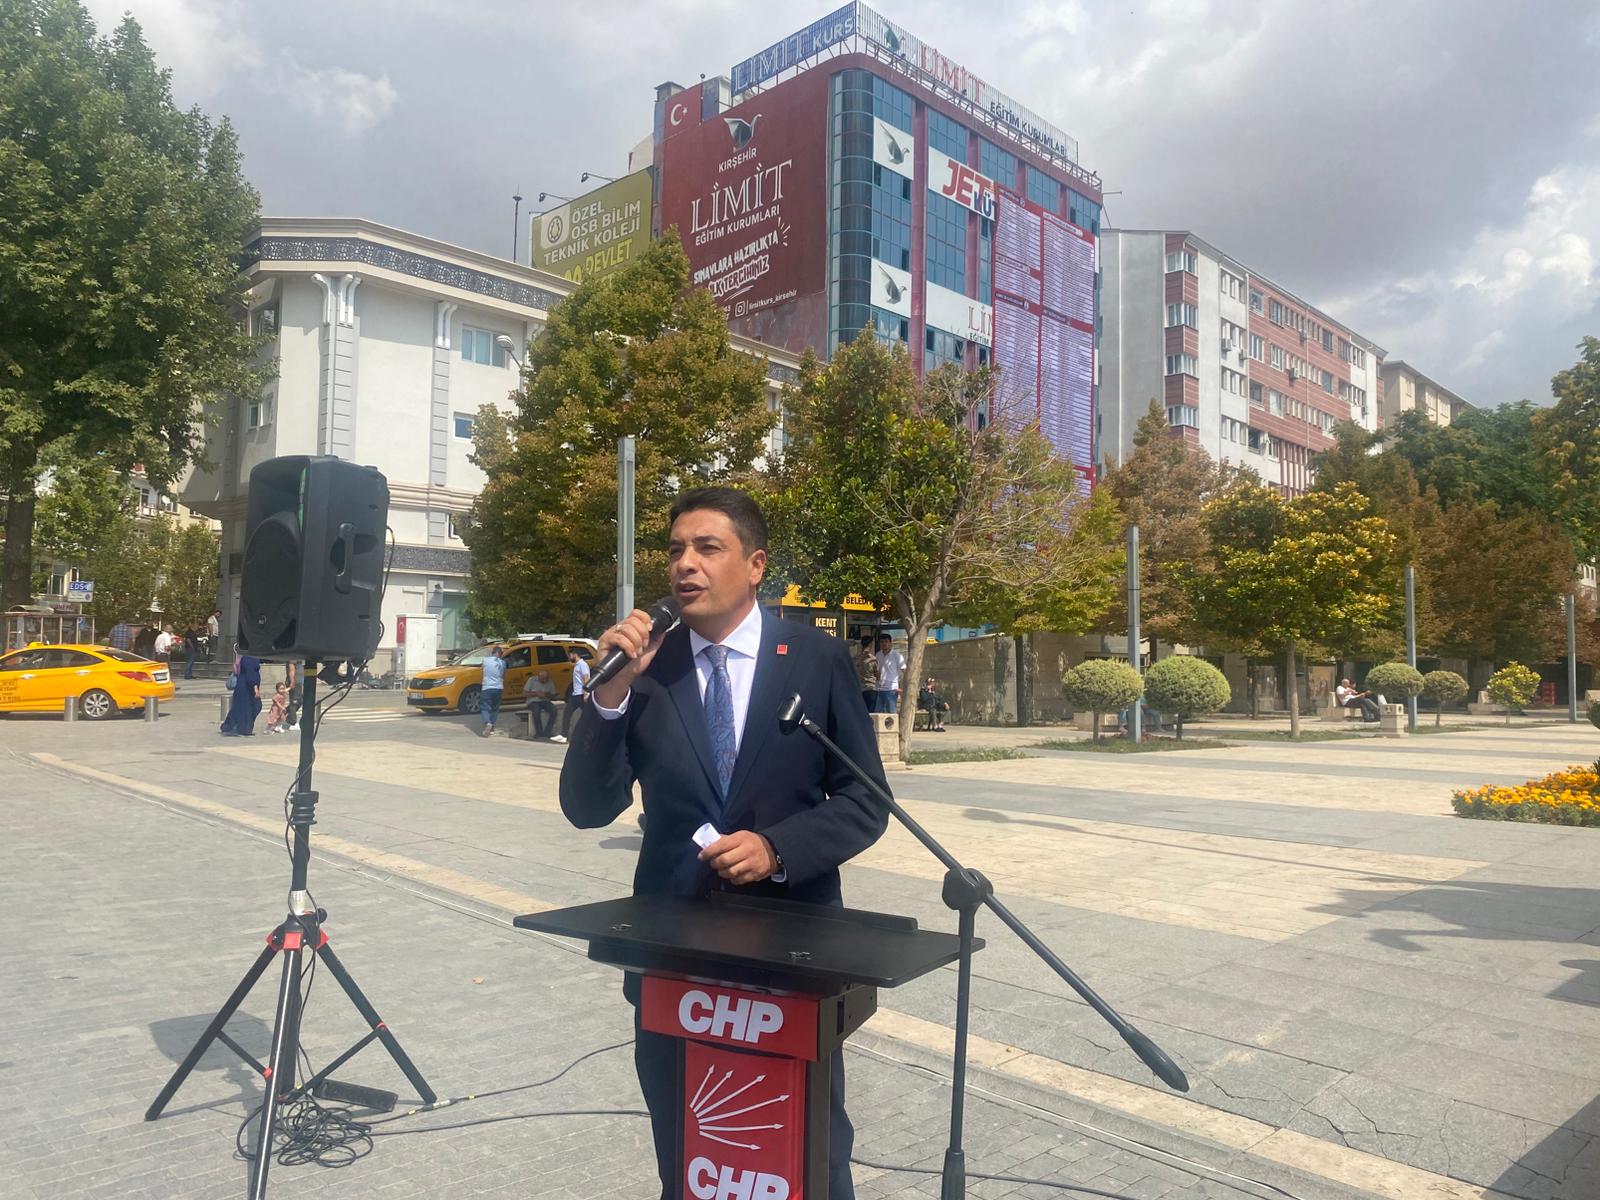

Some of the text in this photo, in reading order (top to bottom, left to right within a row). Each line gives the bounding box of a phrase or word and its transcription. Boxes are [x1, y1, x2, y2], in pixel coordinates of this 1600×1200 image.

[813, 17, 854, 51] KURS
[990, 100, 1020, 128] EĞİTİM
[719, 147, 757, 173] KIRŞEHİR
[690, 159, 792, 234] LİMİT
[943, 159, 994, 208] JET
[571, 200, 641, 239] OSB BİLİM
[572, 200, 605, 223] ÖZEL
[695, 204, 780, 246] EĞİTİM KURUMLARI
[544, 215, 640, 265] TEKNİK KOLEJİ
[585, 239, 632, 275] DEVLET
[693, 230, 778, 284] SINAVLARA HAZIRLIKTA
[815, 617, 837, 628] KENT
[678, 989, 784, 1043] CHP
[687, 1156, 790, 1200] CHP
